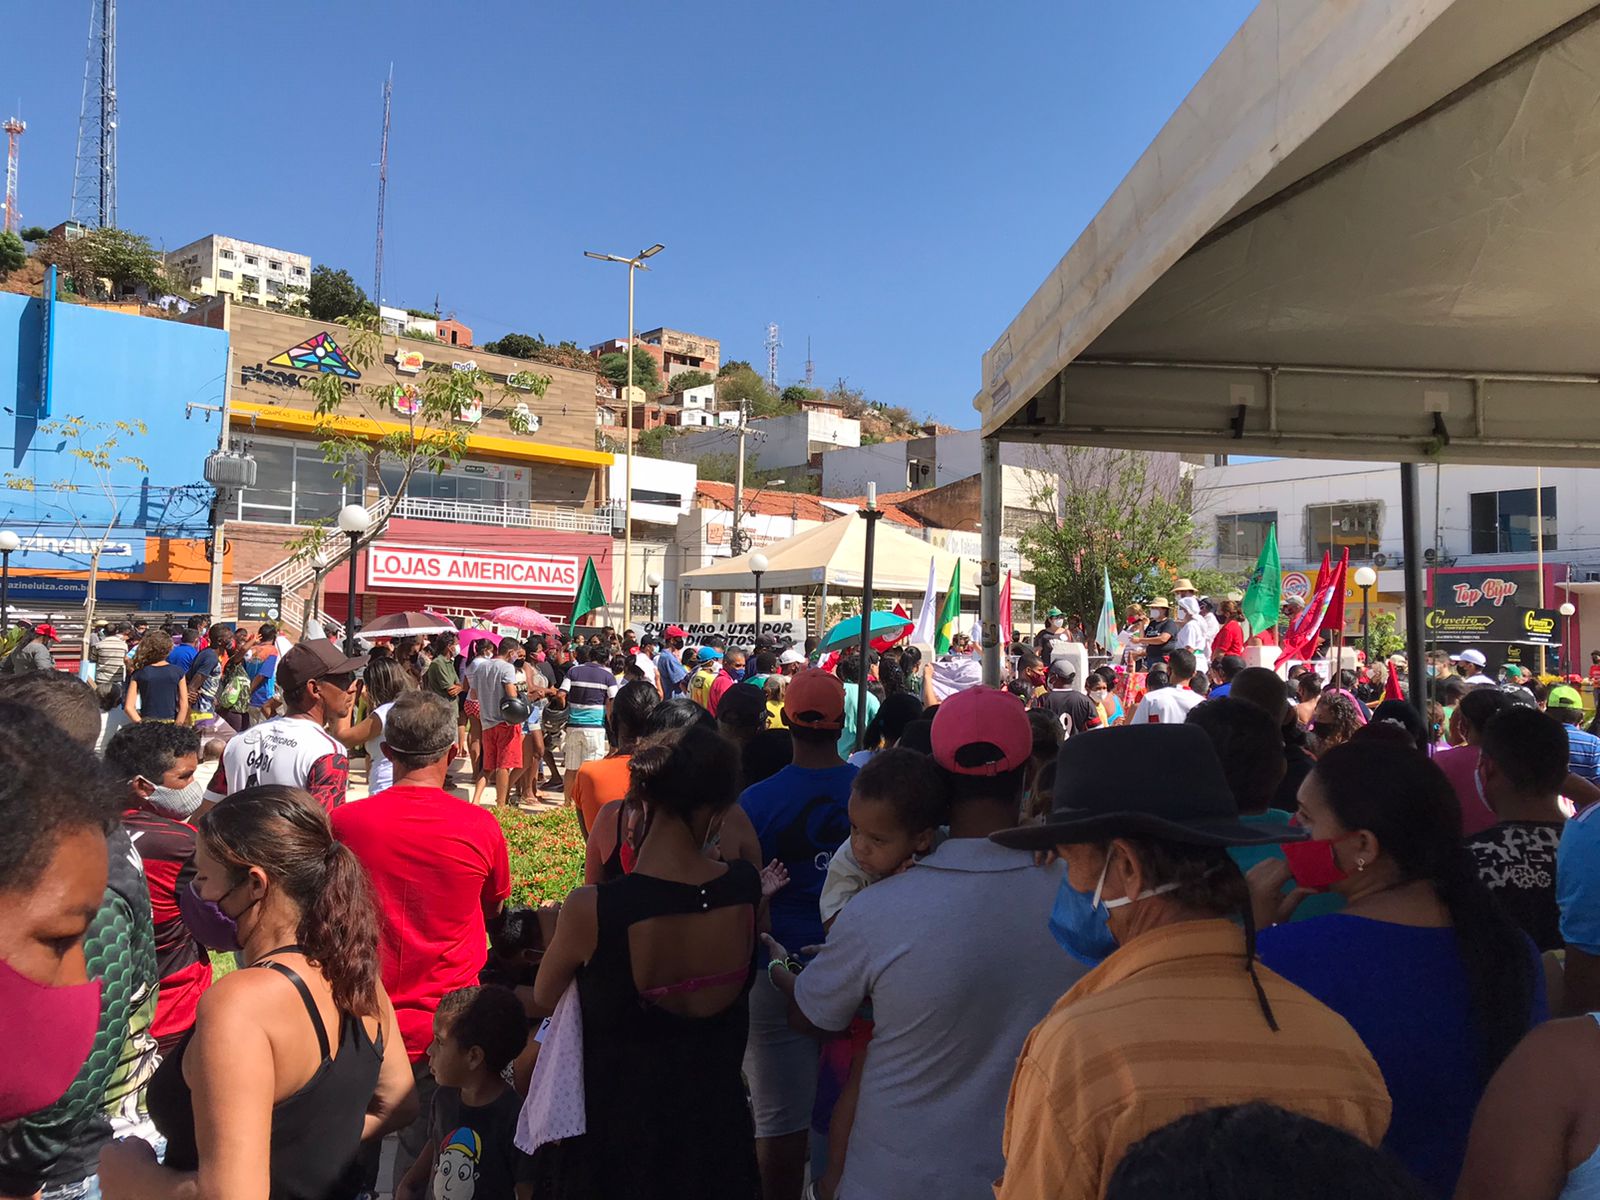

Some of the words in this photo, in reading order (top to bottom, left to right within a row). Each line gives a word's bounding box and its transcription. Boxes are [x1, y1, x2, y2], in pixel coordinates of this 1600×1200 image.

[241, 363, 361, 393] picosceer
[373, 554, 441, 577] LOJAS
[448, 559, 575, 585] AMERICANAS
[1453, 583, 1482, 606] Top
[762, 622, 793, 634] POR
[1425, 609, 1478, 629] Chaveiro
[684, 635, 756, 646] DITOS
[264, 734, 298, 749] mercado
[246, 749, 274, 773] GABI
